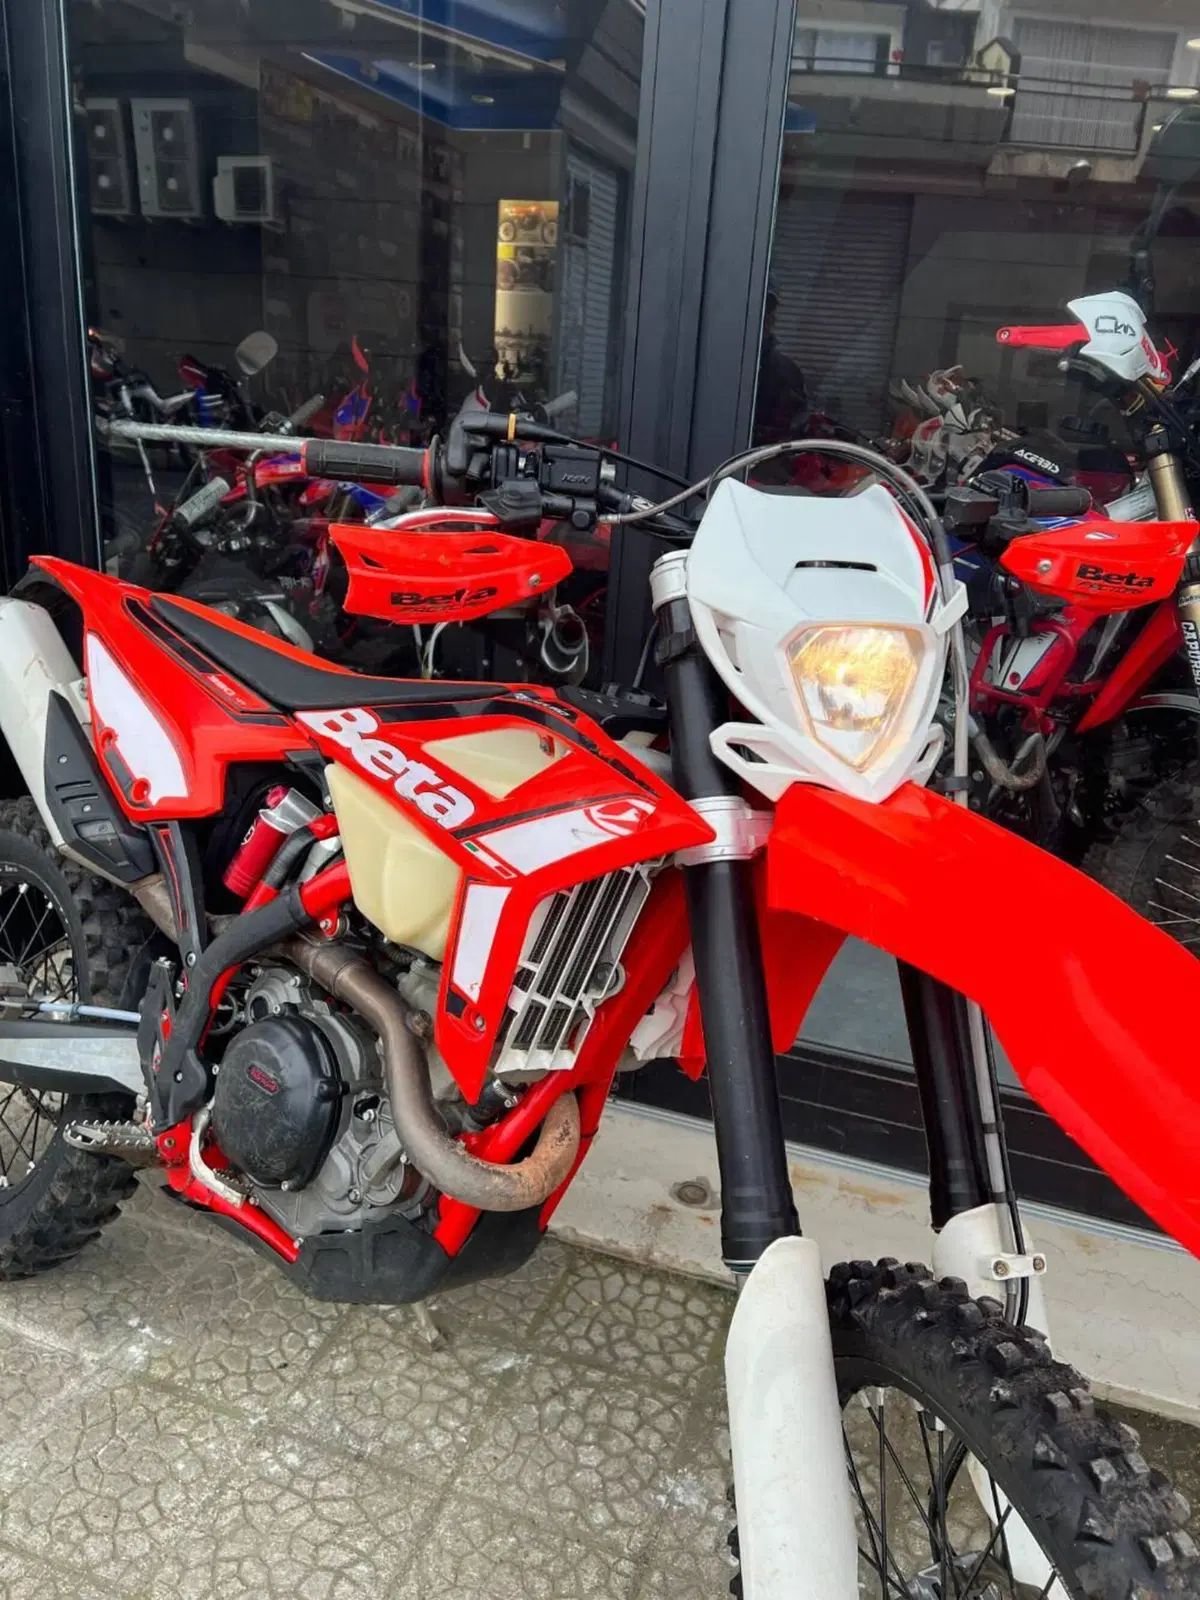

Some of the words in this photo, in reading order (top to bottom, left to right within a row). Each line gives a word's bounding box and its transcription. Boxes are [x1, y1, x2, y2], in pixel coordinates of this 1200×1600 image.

[1076, 563, 1156, 587] Beta
[390, 586, 498, 606] Beta
[294, 707, 476, 830] Beta
